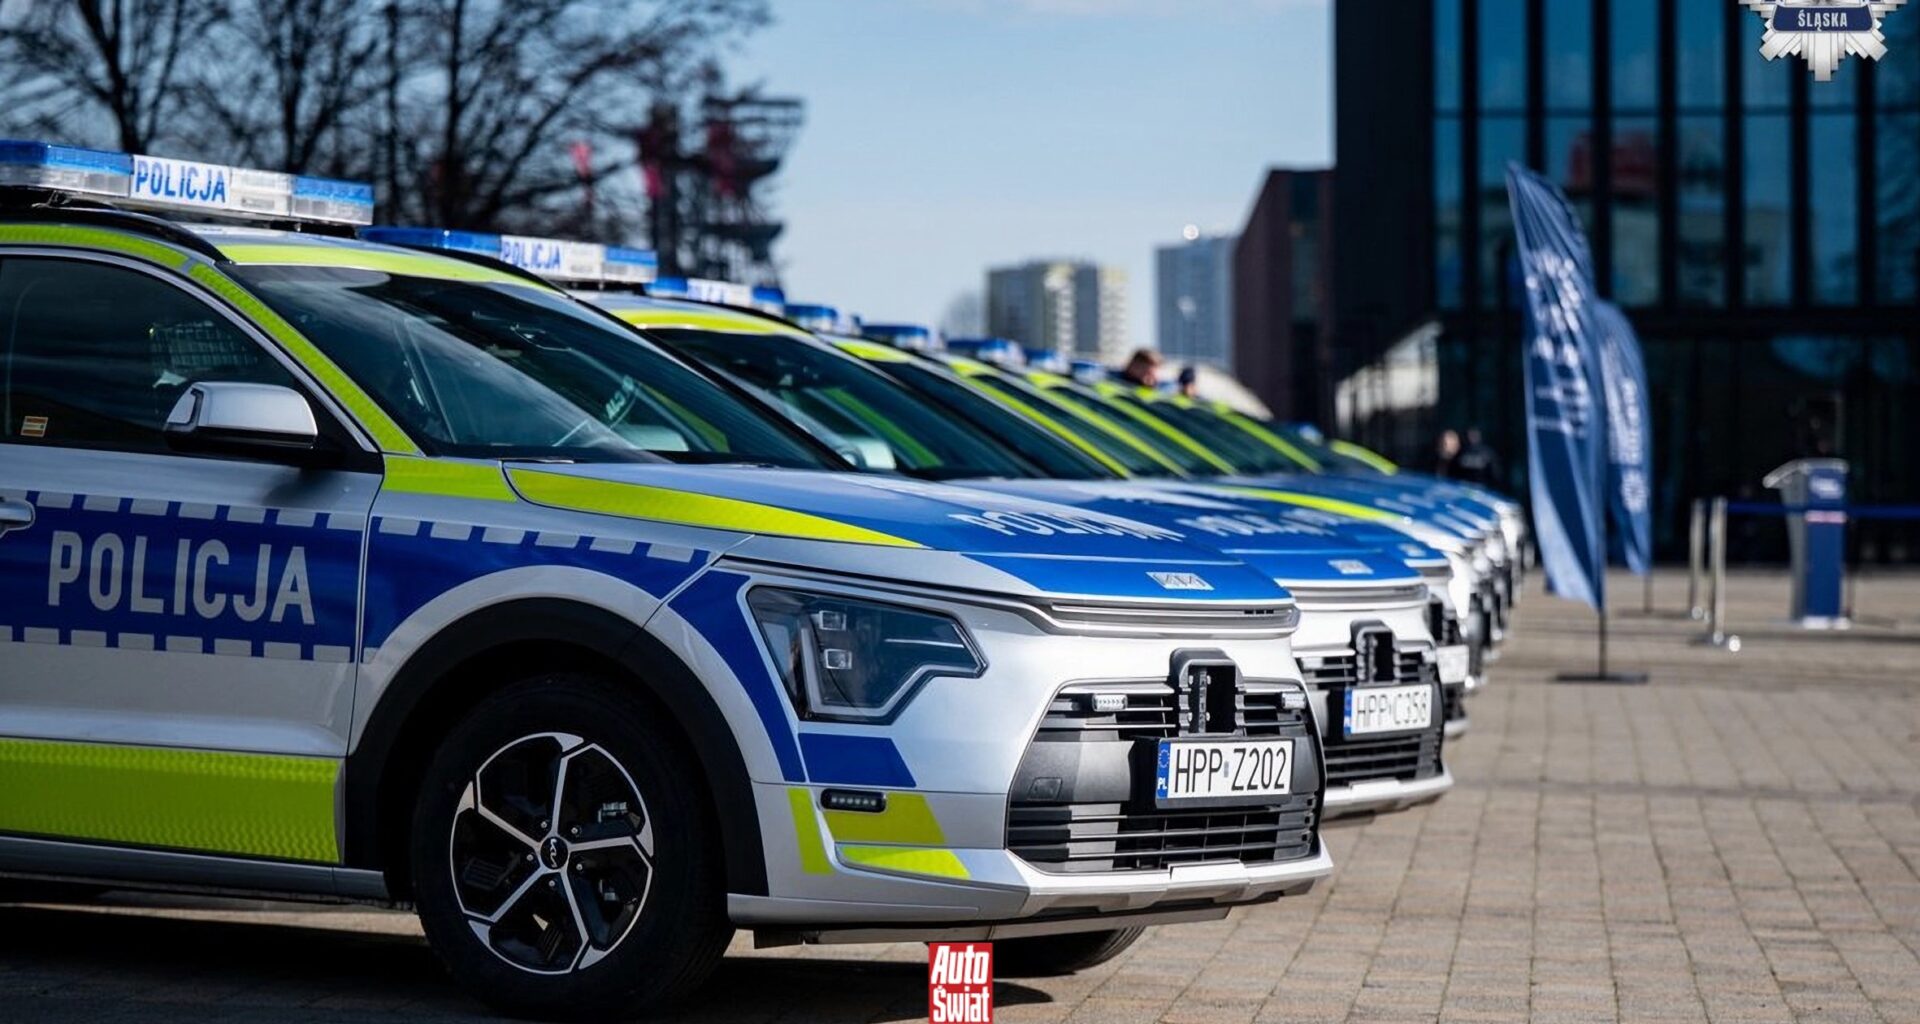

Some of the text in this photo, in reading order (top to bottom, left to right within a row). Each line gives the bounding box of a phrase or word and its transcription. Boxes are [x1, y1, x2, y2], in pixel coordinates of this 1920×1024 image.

[135, 159, 226, 203] POLICJA
[502, 240, 561, 270] POLICJA
[48, 530, 315, 625] POLICJA
[1157, 776, 1168, 790] PL
[1174, 747, 1287, 793] HPP Z202
